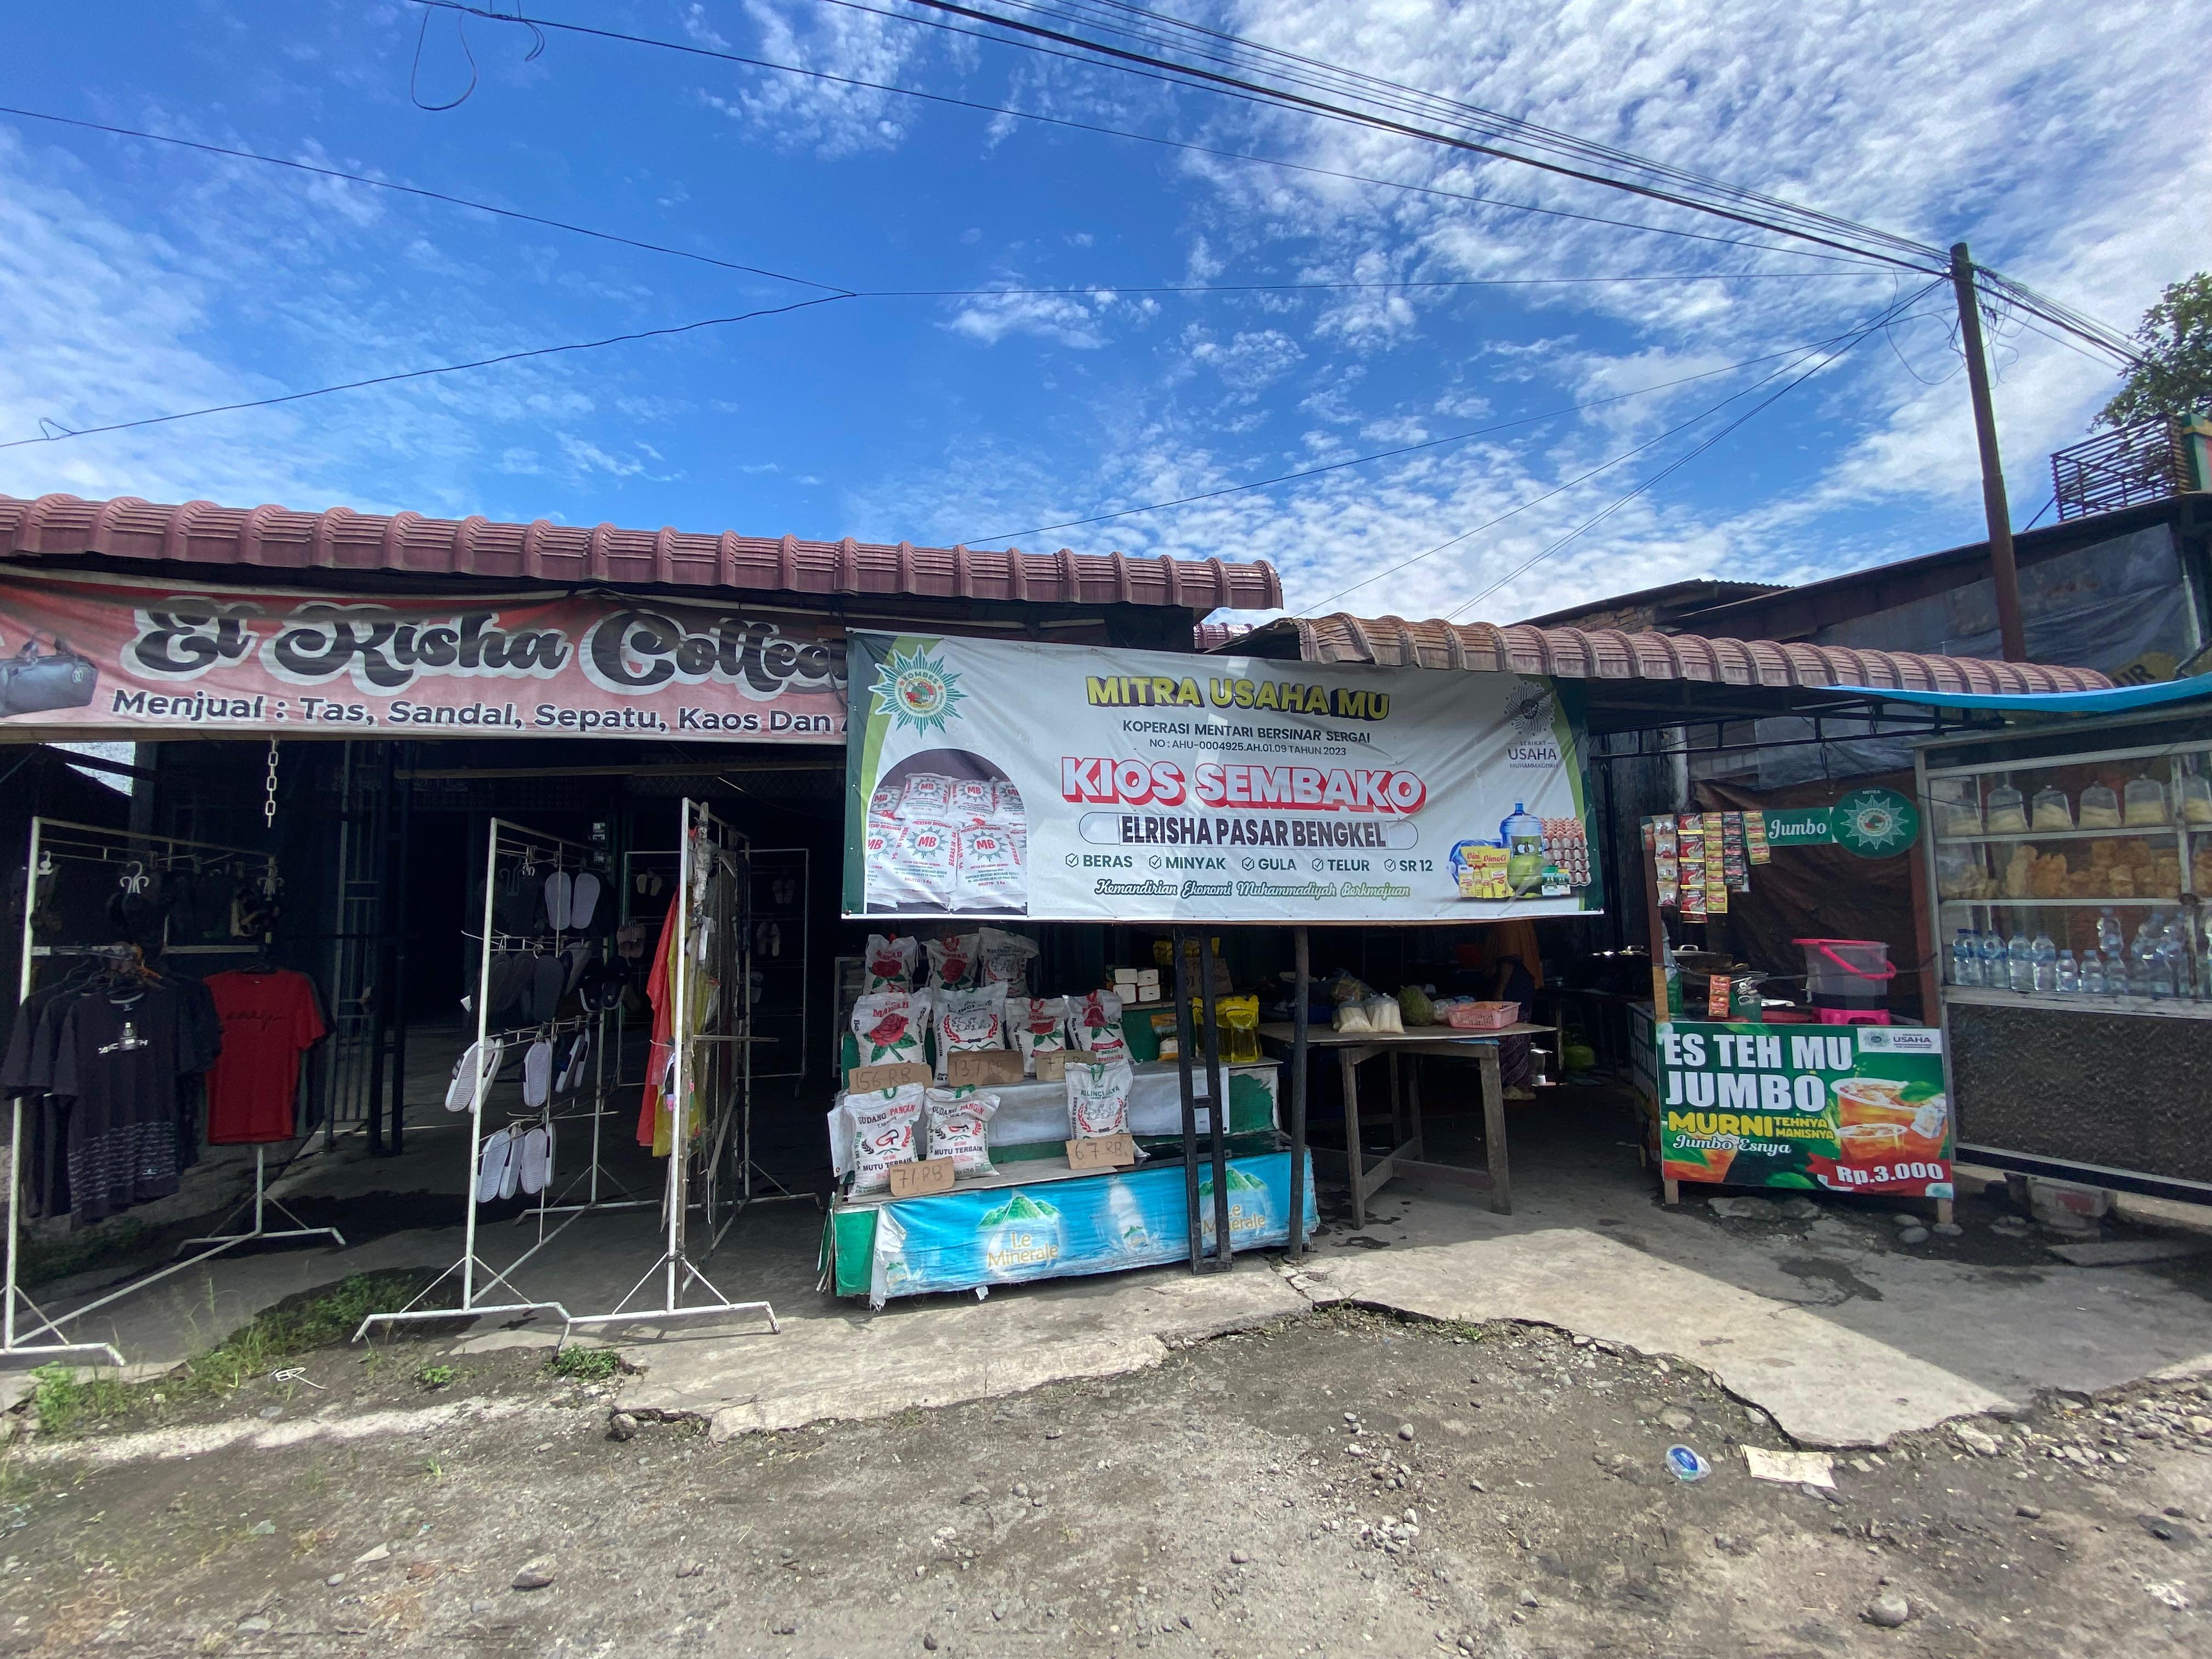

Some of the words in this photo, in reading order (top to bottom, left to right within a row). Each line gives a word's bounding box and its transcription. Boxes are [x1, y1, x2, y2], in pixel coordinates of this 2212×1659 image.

[127, 596, 255, 676] El
[902, 671, 939, 684] KOMBES
[1086, 676, 1205, 708] MITRA
[1210, 678, 1330, 715] USAHA
[1332, 688, 1390, 721] MU
[113, 690, 264, 721] Menjual
[300, 697, 375, 725] Tas,
[387, 701, 522, 728] Sandal,
[532, 704, 665, 731] Sepatu,
[679, 708, 758, 730] Kaos
[770, 710, 831, 731] Dan
[1123, 720, 1189, 734] KOPERASI
[1195, 724, 1253, 737] MENTARI
[1258, 727, 1322, 741] BERSINAR
[1326, 731, 1370, 743] SERGAI
[1289, 746, 1322, 755] TAHUN
[1323, 747, 1346, 755] 2023
[1508, 748, 1557, 760] USAHA
[967, 786, 981, 794] MB
[1062, 757, 1186, 807] KIOS
[1195, 763, 1426, 814] SEMBAKO
[1122, 816, 1212, 845] ELRISHA
[1216, 818, 1289, 847] PASAR
[1292, 821, 1386, 847] BENGKEL
[1768, 819, 1826, 839] Jumbo
[918, 836, 937, 847] MB
[977, 839, 995, 850] MB
[1083, 855, 1133, 867] BERAS
[1166, 856, 1226, 870] MINYAK
[1259, 859, 1297, 870] GULA
[1327, 859, 1370, 871] TELUR
[1400, 860, 1417, 871] SR
[1420, 860, 1433, 872] 12
[1094, 879, 1178, 895] Kemandirian
[1181, 880, 1232, 899] Ekonomi
[1237, 882, 1336, 900] Muhammadiyah
[1664, 1034, 1706, 1066] ES
[1713, 1035, 1782, 1068] TEH
[1791, 1036, 1852, 1070] MU
[955, 1059, 981, 1077] 137
[1666, 1071, 1826, 1111] JUMBO
[859, 1113, 887, 1124] GUDANG
[1668, 1111, 1773, 1137] MURNI
[1774, 1116, 1829, 1128] TEHNYA
[1776, 1128, 1835, 1139] MANISNYA
[955, 1146, 983, 1154] TERBAIK
[1673, 1135, 1733, 1149] Jumbo
[1738, 1139, 1792, 1156] Esnya
[1836, 1162, 1944, 1185] Rp.3.000
[1012, 1232, 1031, 1249] Le
[988, 1243, 1058, 1268] Minerale
